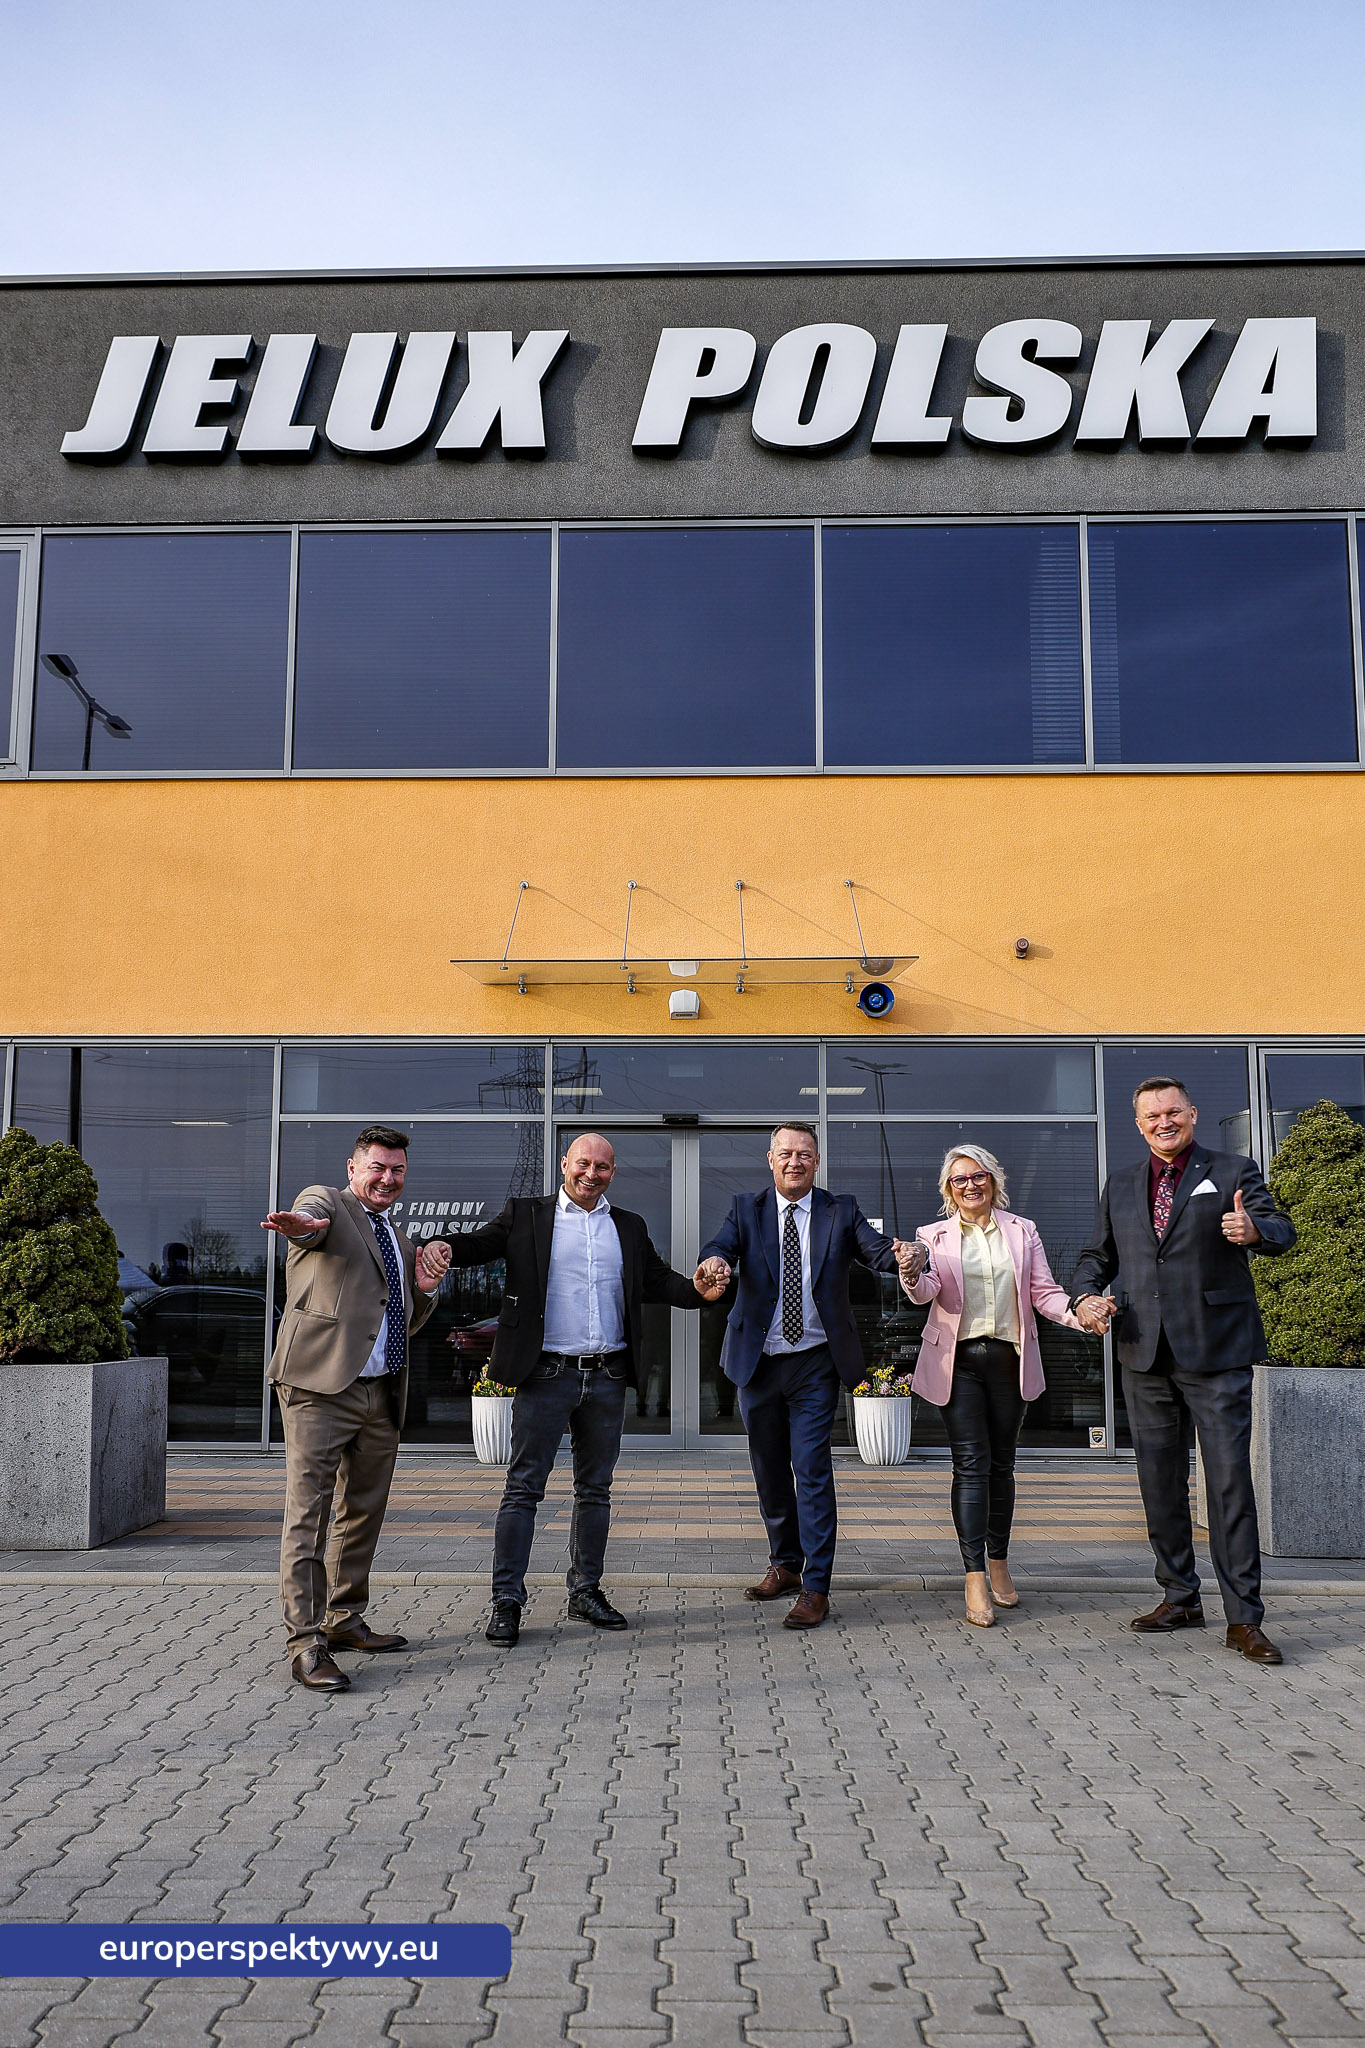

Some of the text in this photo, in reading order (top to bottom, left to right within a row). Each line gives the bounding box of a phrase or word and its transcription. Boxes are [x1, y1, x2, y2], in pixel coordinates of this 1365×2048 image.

[60, 316, 1318, 460] JELUX POLSKA
[408, 1201, 485, 1216] FIRMOWY
